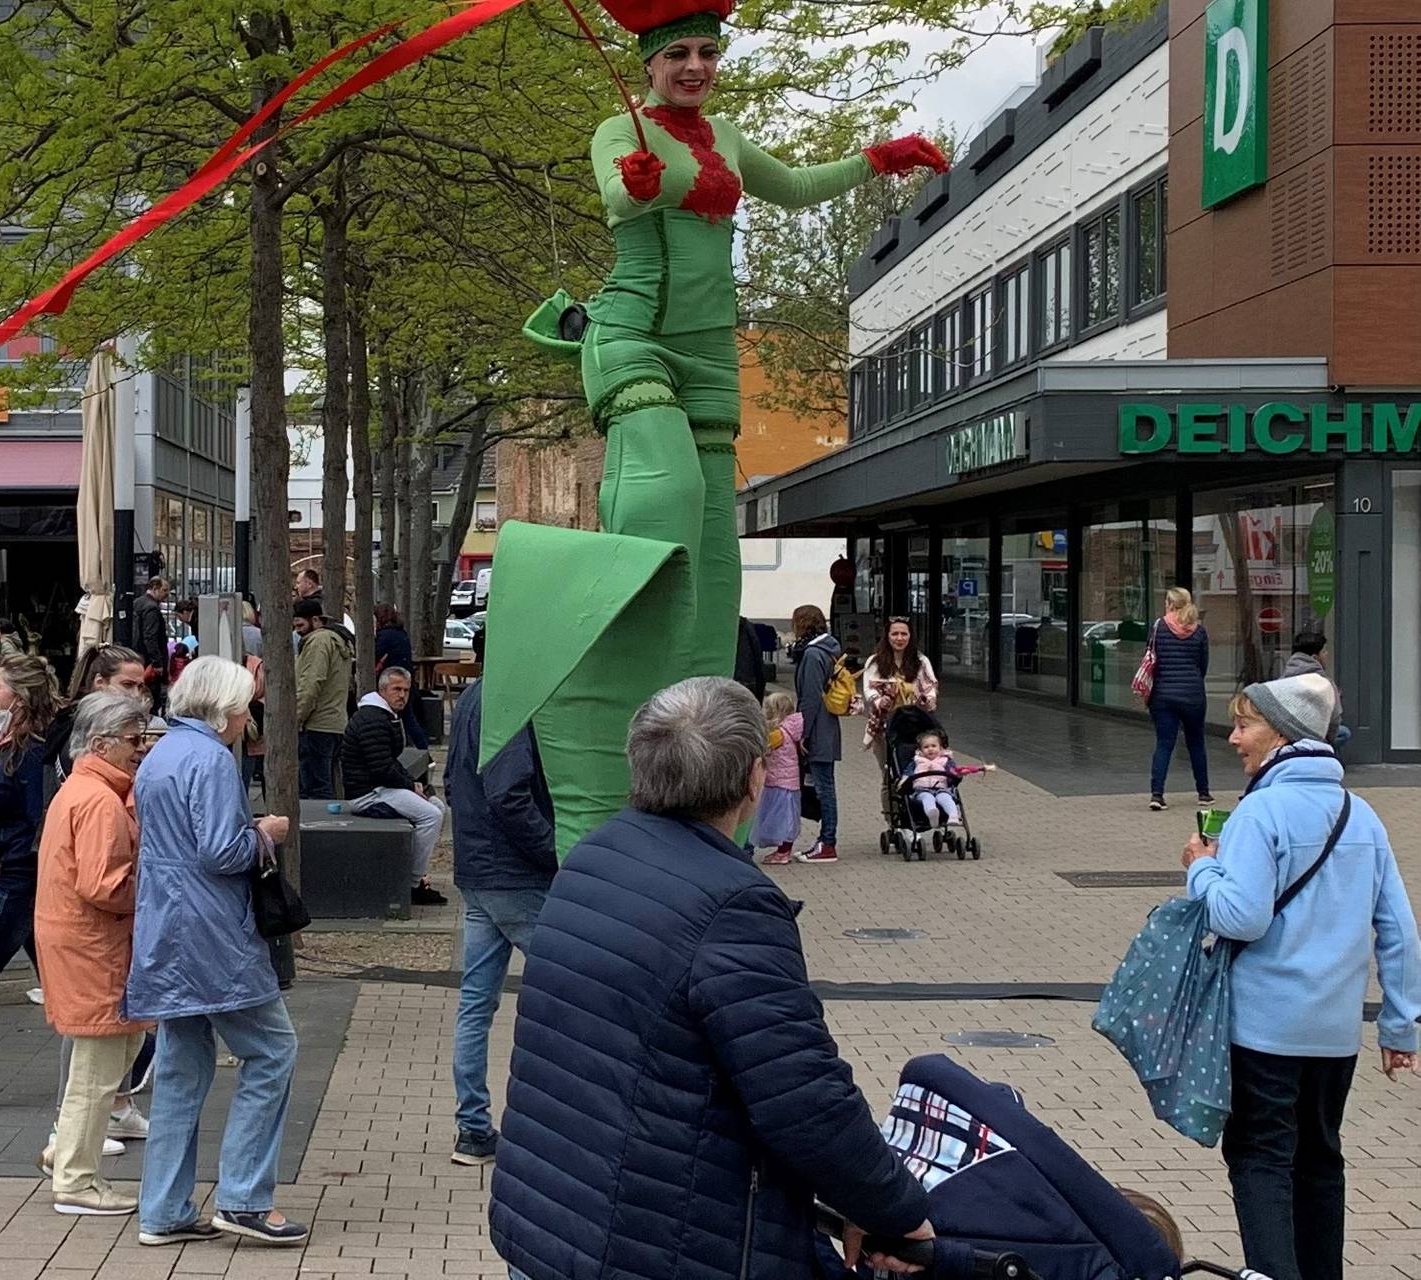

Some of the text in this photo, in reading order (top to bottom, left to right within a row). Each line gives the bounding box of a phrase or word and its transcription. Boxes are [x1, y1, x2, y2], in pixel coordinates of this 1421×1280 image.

[1214, 26, 1249, 155] D
[1353, 497, 1372, 513] 10
[1311, 550, 1334, 573] -20%
